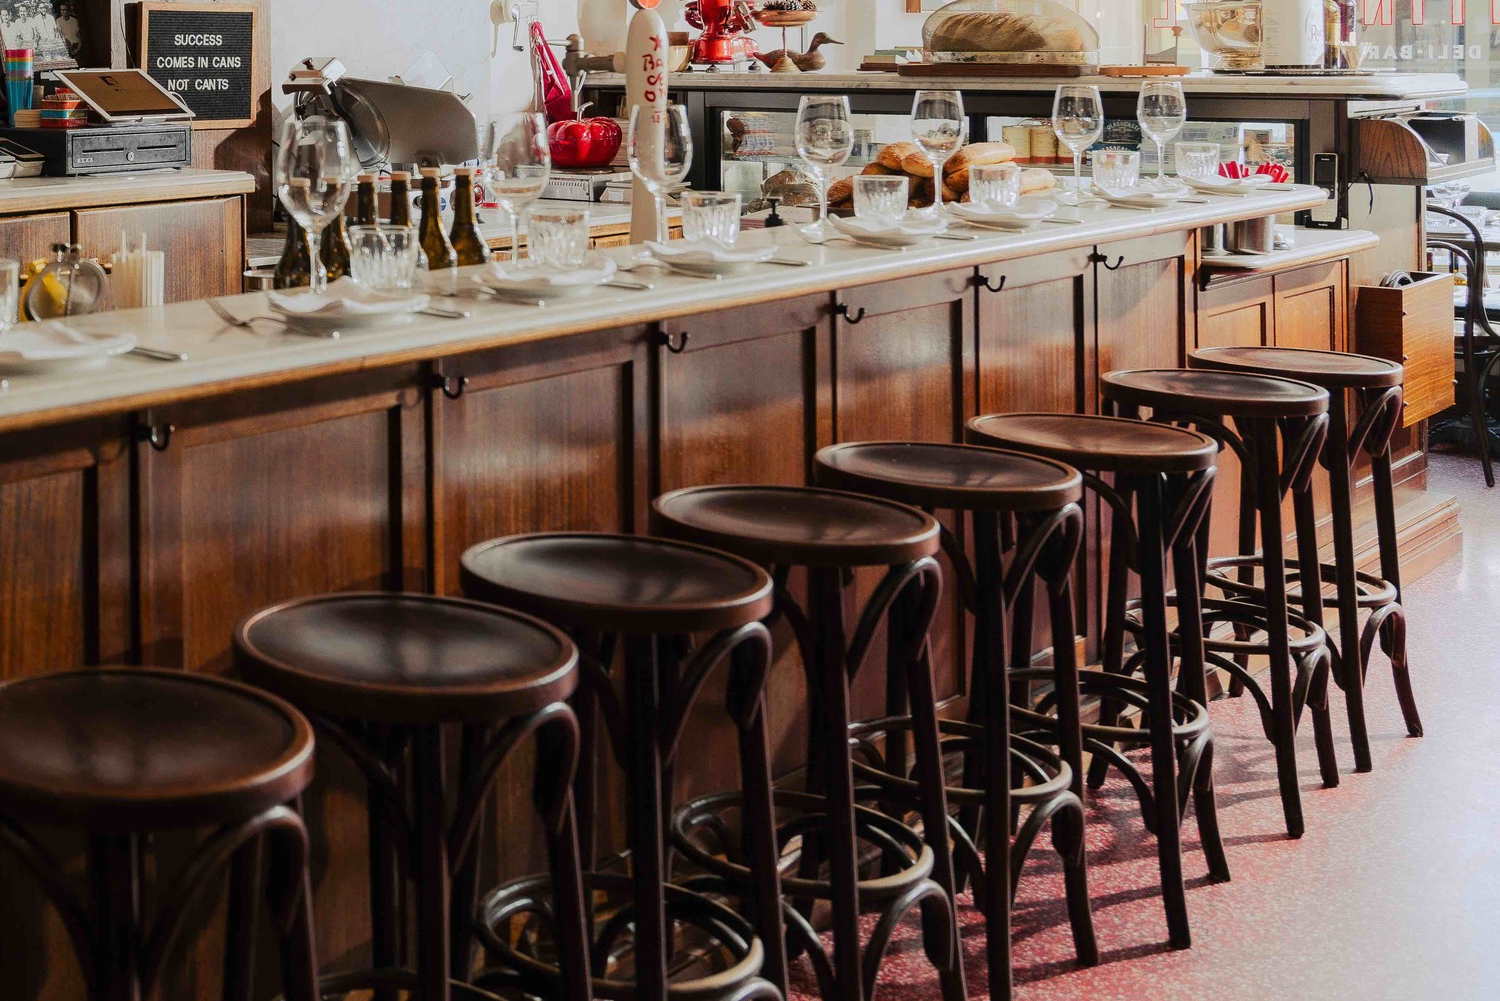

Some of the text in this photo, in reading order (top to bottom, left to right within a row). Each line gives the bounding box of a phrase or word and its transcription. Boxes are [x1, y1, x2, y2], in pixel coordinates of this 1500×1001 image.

[174, 34, 223, 46] SUCCESS
[157, 56, 241, 68] COMES IN CANS
[168, 79, 229, 91] NOT CANTS
